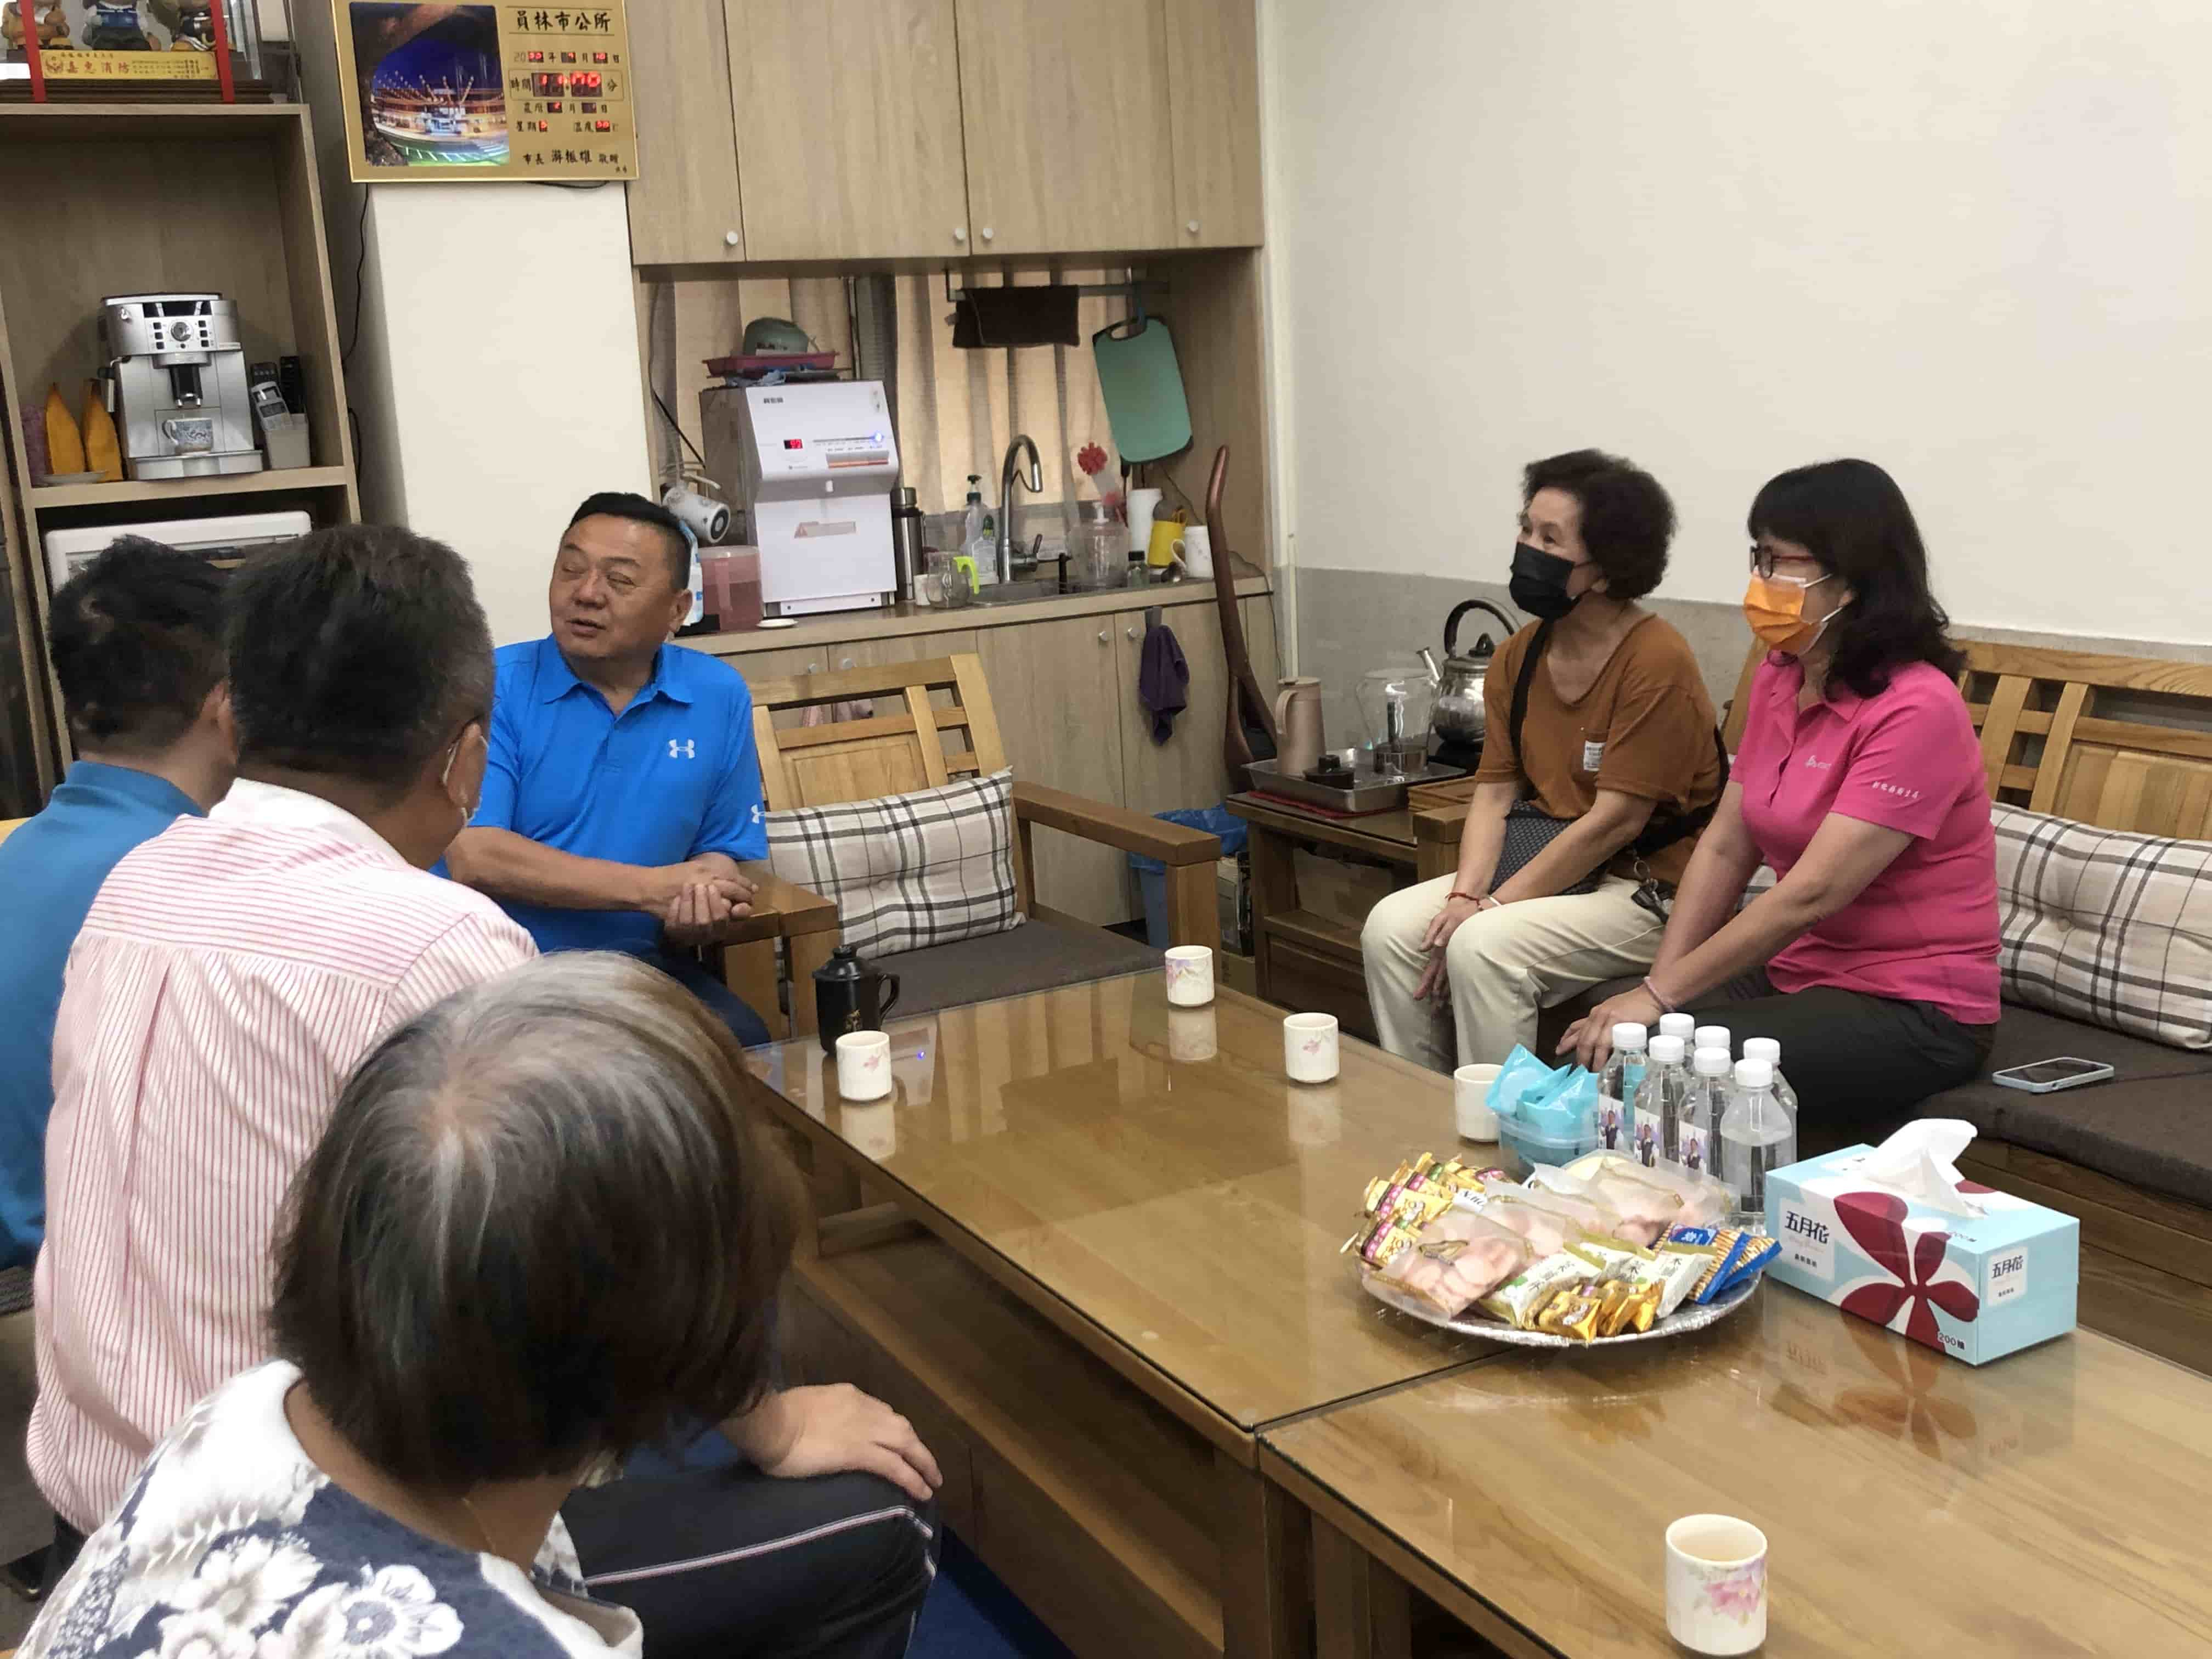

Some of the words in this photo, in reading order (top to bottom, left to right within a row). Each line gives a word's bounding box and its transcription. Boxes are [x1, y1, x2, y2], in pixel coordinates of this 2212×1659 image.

[516, 10, 612, 32] 員林市公所
[1785, 1211, 1830, 1244] 五月花
[1991, 1255, 2023, 1279] 五月花
